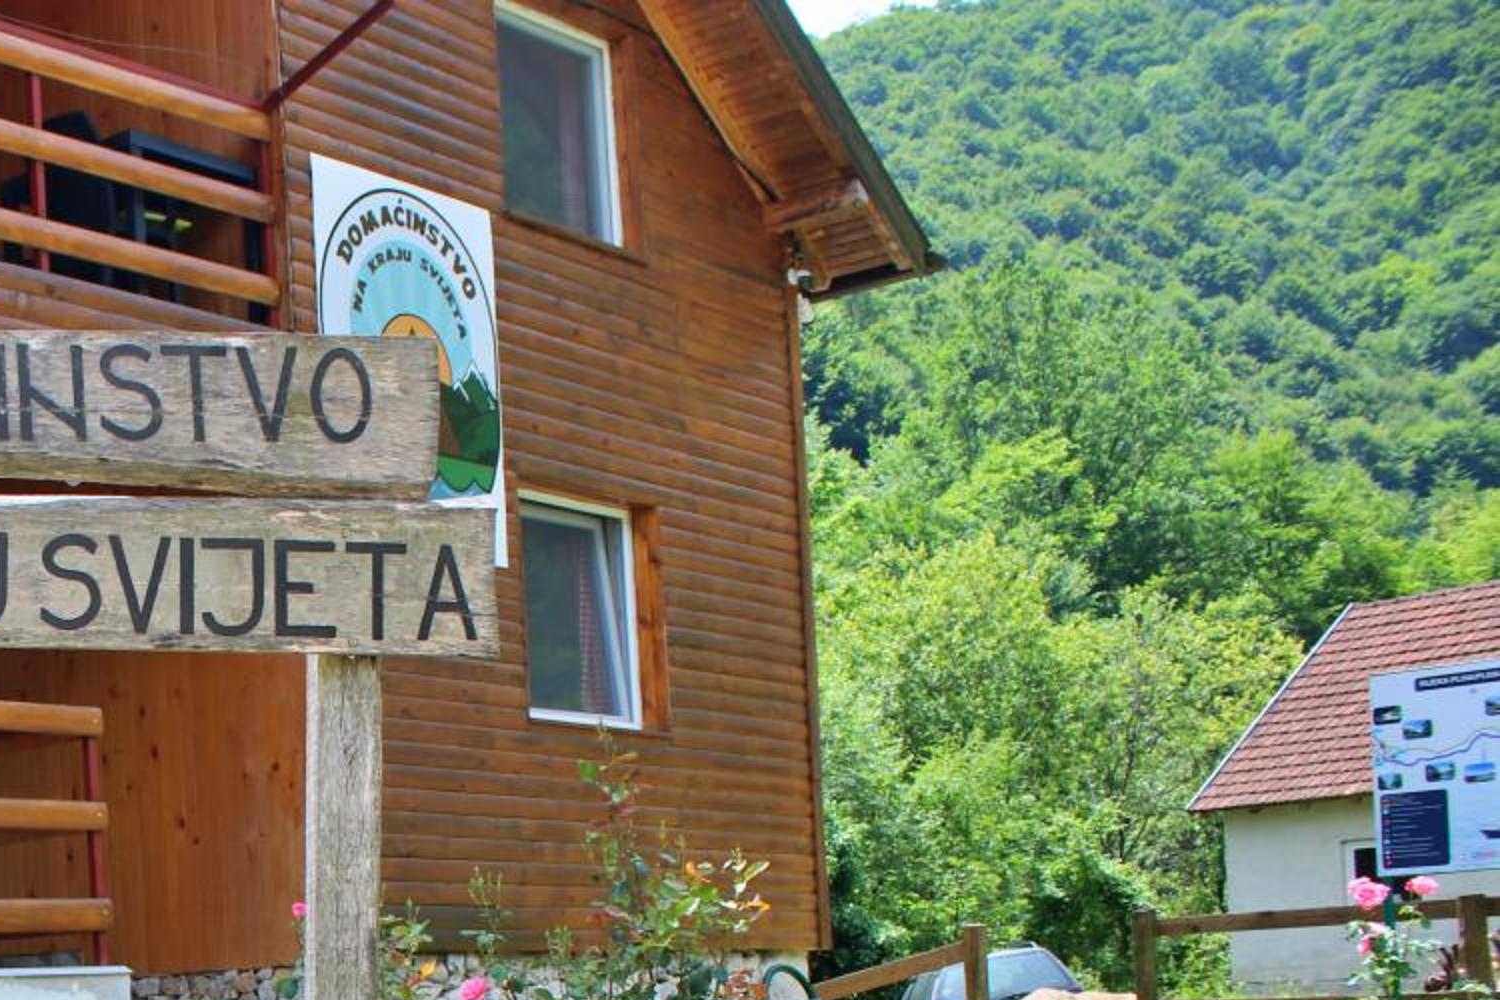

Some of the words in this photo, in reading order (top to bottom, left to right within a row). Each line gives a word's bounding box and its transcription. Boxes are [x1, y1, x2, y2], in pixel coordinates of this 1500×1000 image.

[336, 197, 477, 300] DOMAĆINSTVO
[367, 248, 412, 274] KRAJU
[39, 533, 478, 642] SVIJETA
